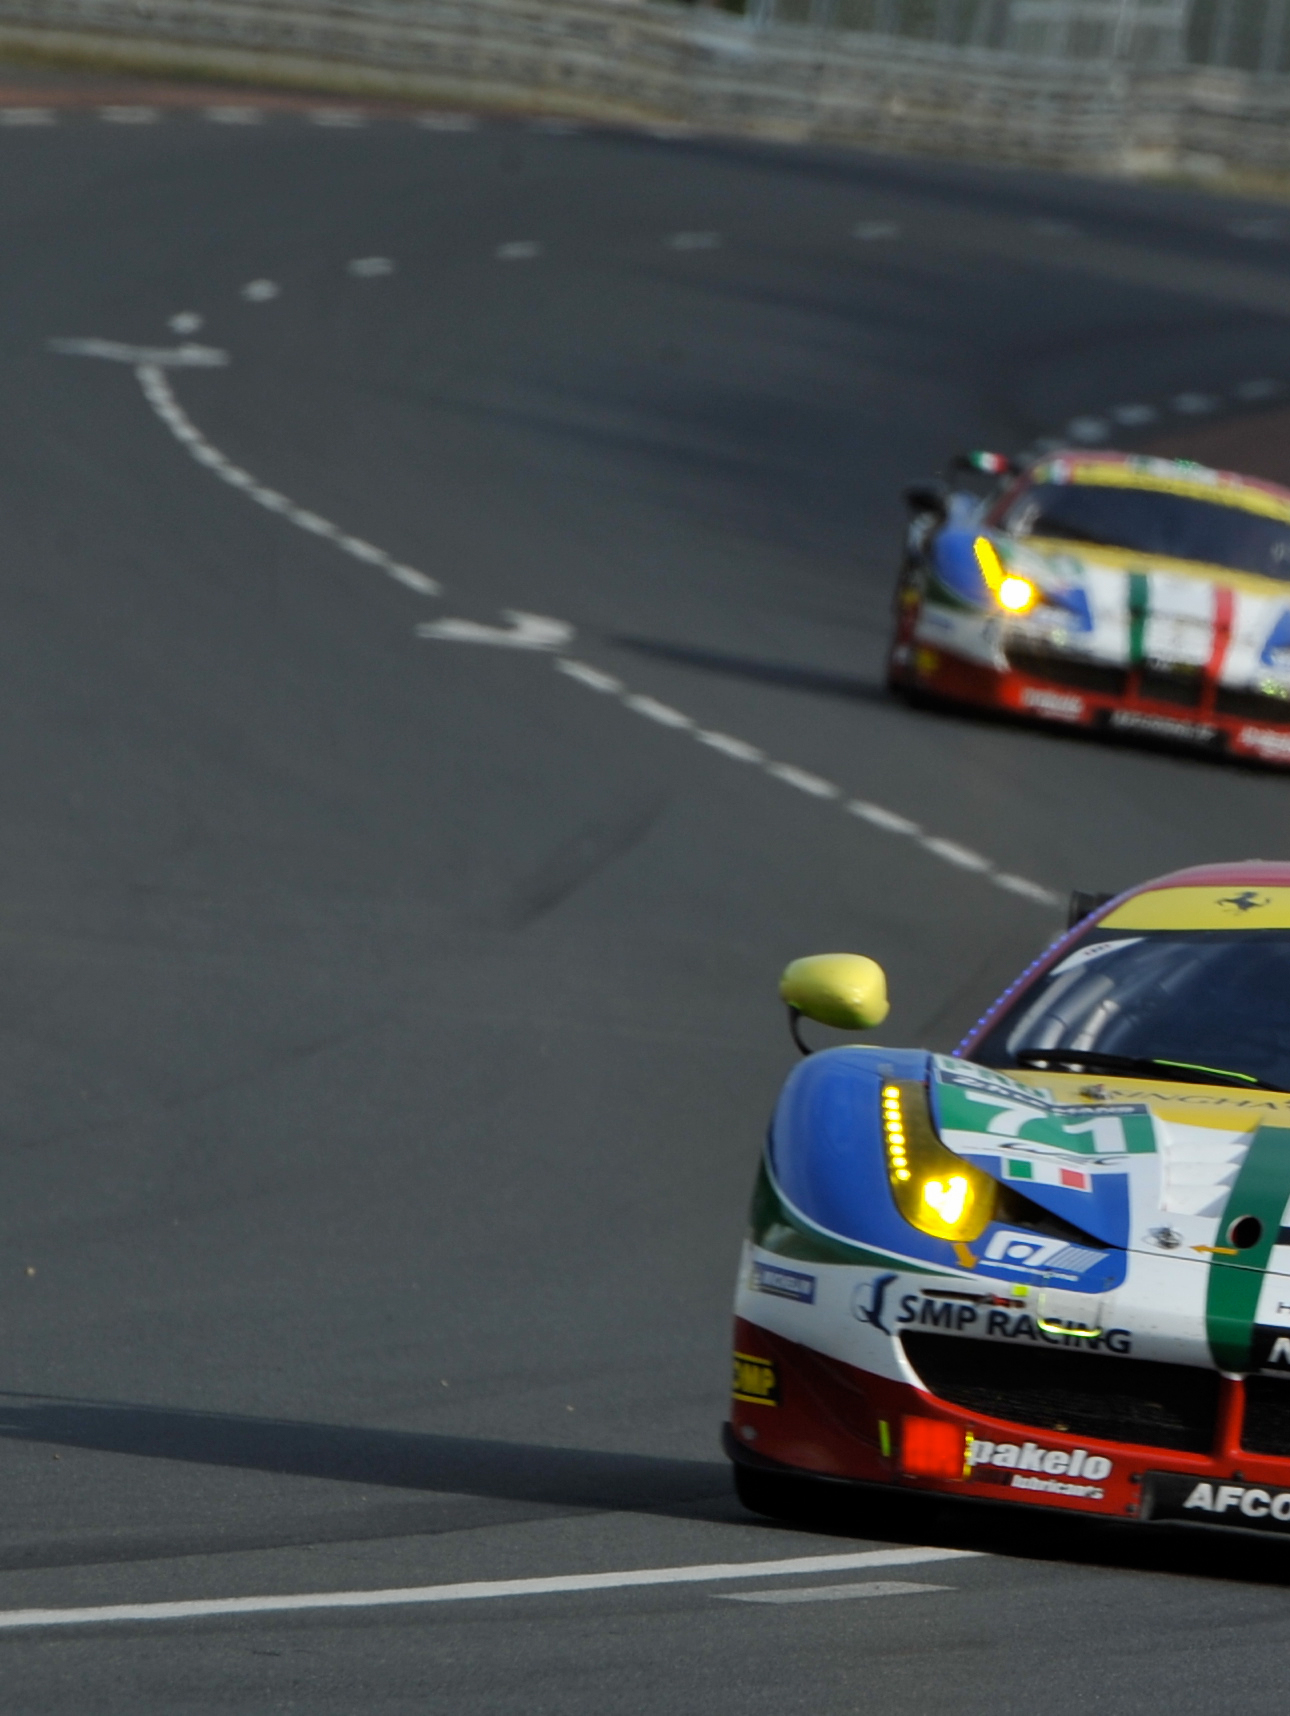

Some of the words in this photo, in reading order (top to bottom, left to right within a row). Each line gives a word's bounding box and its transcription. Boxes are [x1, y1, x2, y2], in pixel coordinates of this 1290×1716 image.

[963, 1089, 1128, 1153] 71
[898, 1295, 978, 1331] SMP
[985, 1309, 1132, 1354] RACING
[968, 1440, 1113, 1481] pakelo
